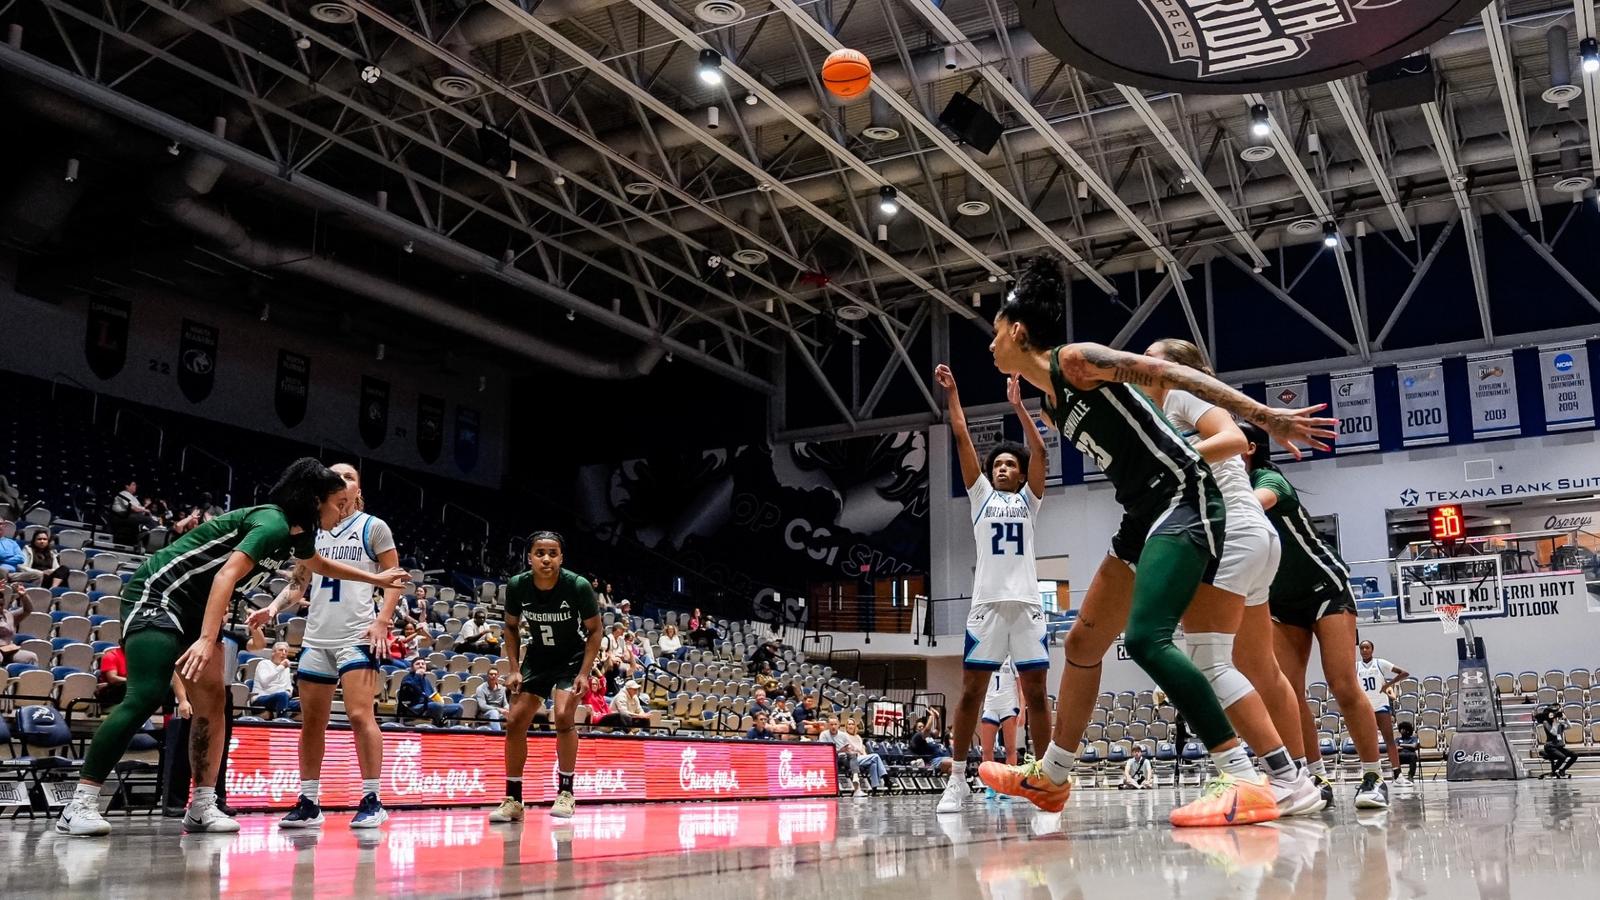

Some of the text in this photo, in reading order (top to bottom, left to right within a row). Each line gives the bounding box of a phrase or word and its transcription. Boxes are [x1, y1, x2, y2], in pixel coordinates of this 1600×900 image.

[1157, 0, 1194, 51] PREYS
[1185, 0, 1299, 72] RIDA
[1558, 391, 1577, 402] 2003
[1484, 409, 1507, 421] 2003
[1558, 401, 1579, 412] 2004
[1338, 416, 1372, 435] 2020
[1407, 408, 1442, 427] 2020
[1425, 486, 1497, 503] TEXANA
[1501, 481, 1551, 498] BANK
[1433, 515, 1461, 538] 30
[1544, 514, 1592, 533] Ospreys
[990, 522, 1025, 556] 24
[331, 547, 363, 562] FLORIDA
[320, 576, 341, 603] 4
[1539, 581, 1576, 599] HAYT
[1507, 601, 1560, 618] UTLOOK
[540, 625, 556, 646] 2
[1363, 677, 1376, 692] 30
